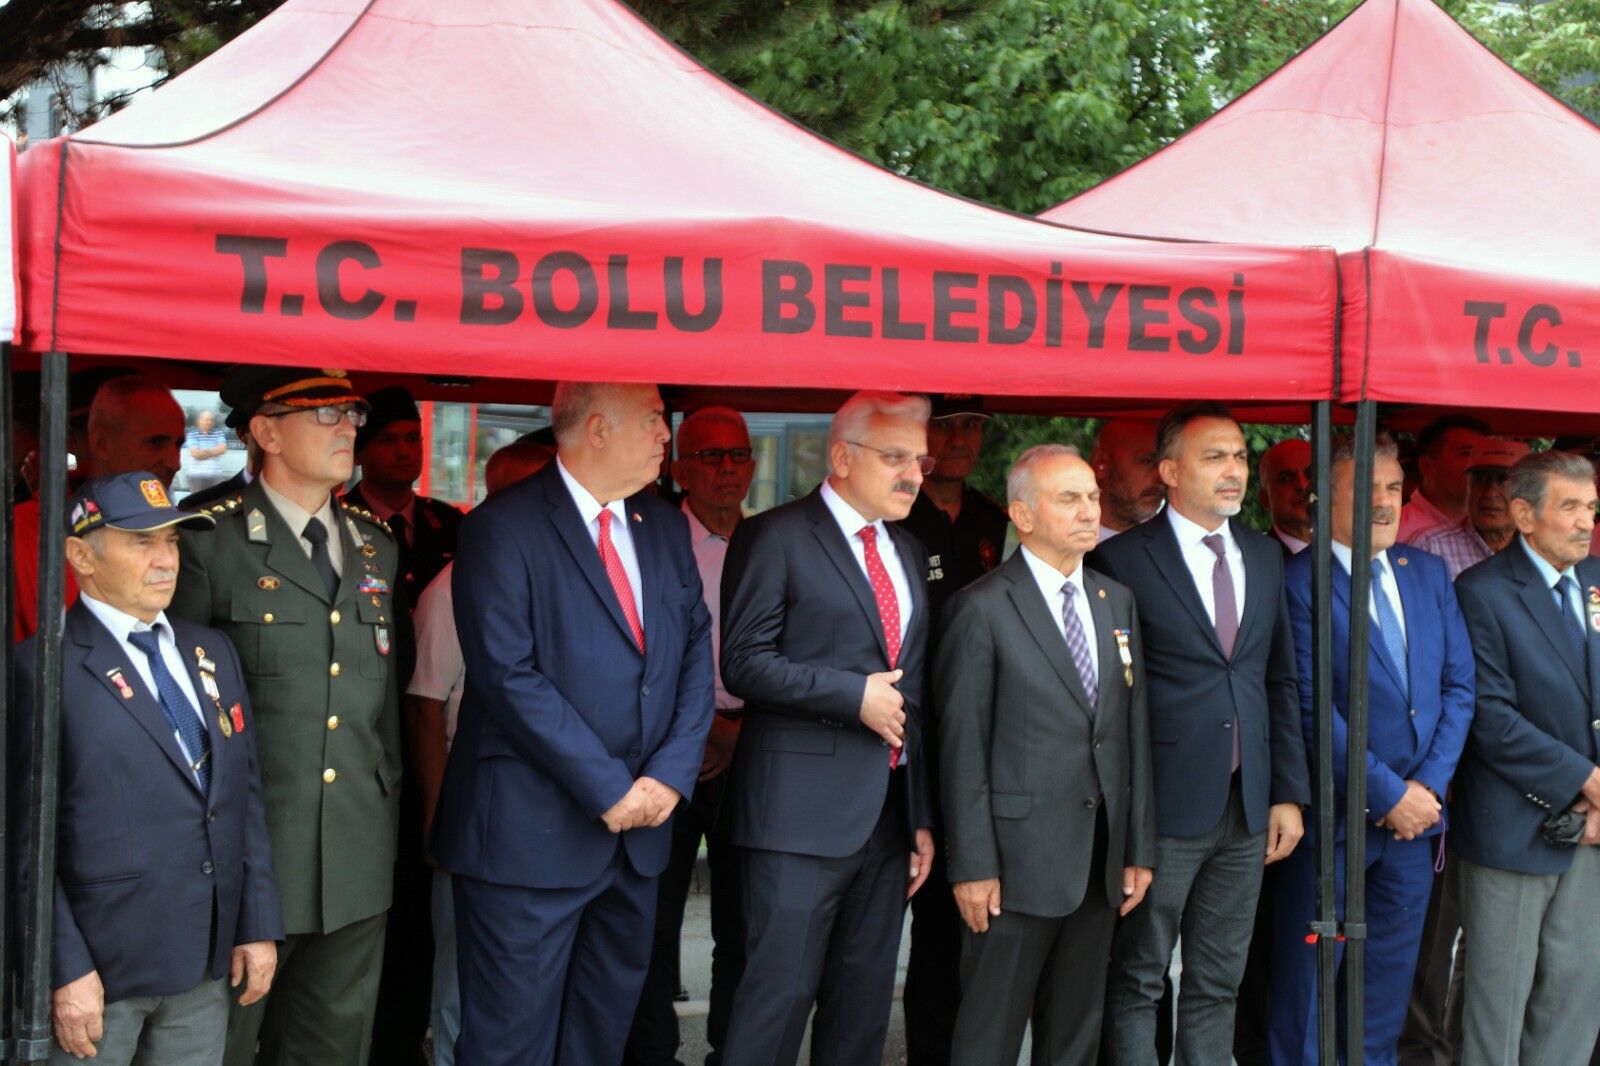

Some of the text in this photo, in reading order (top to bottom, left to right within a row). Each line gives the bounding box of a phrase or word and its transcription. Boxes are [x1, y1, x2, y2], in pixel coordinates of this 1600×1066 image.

[215, 233, 1246, 356] T.C. BOLU BELEDİYESİ
[1464, 301, 1581, 367] T.C.
